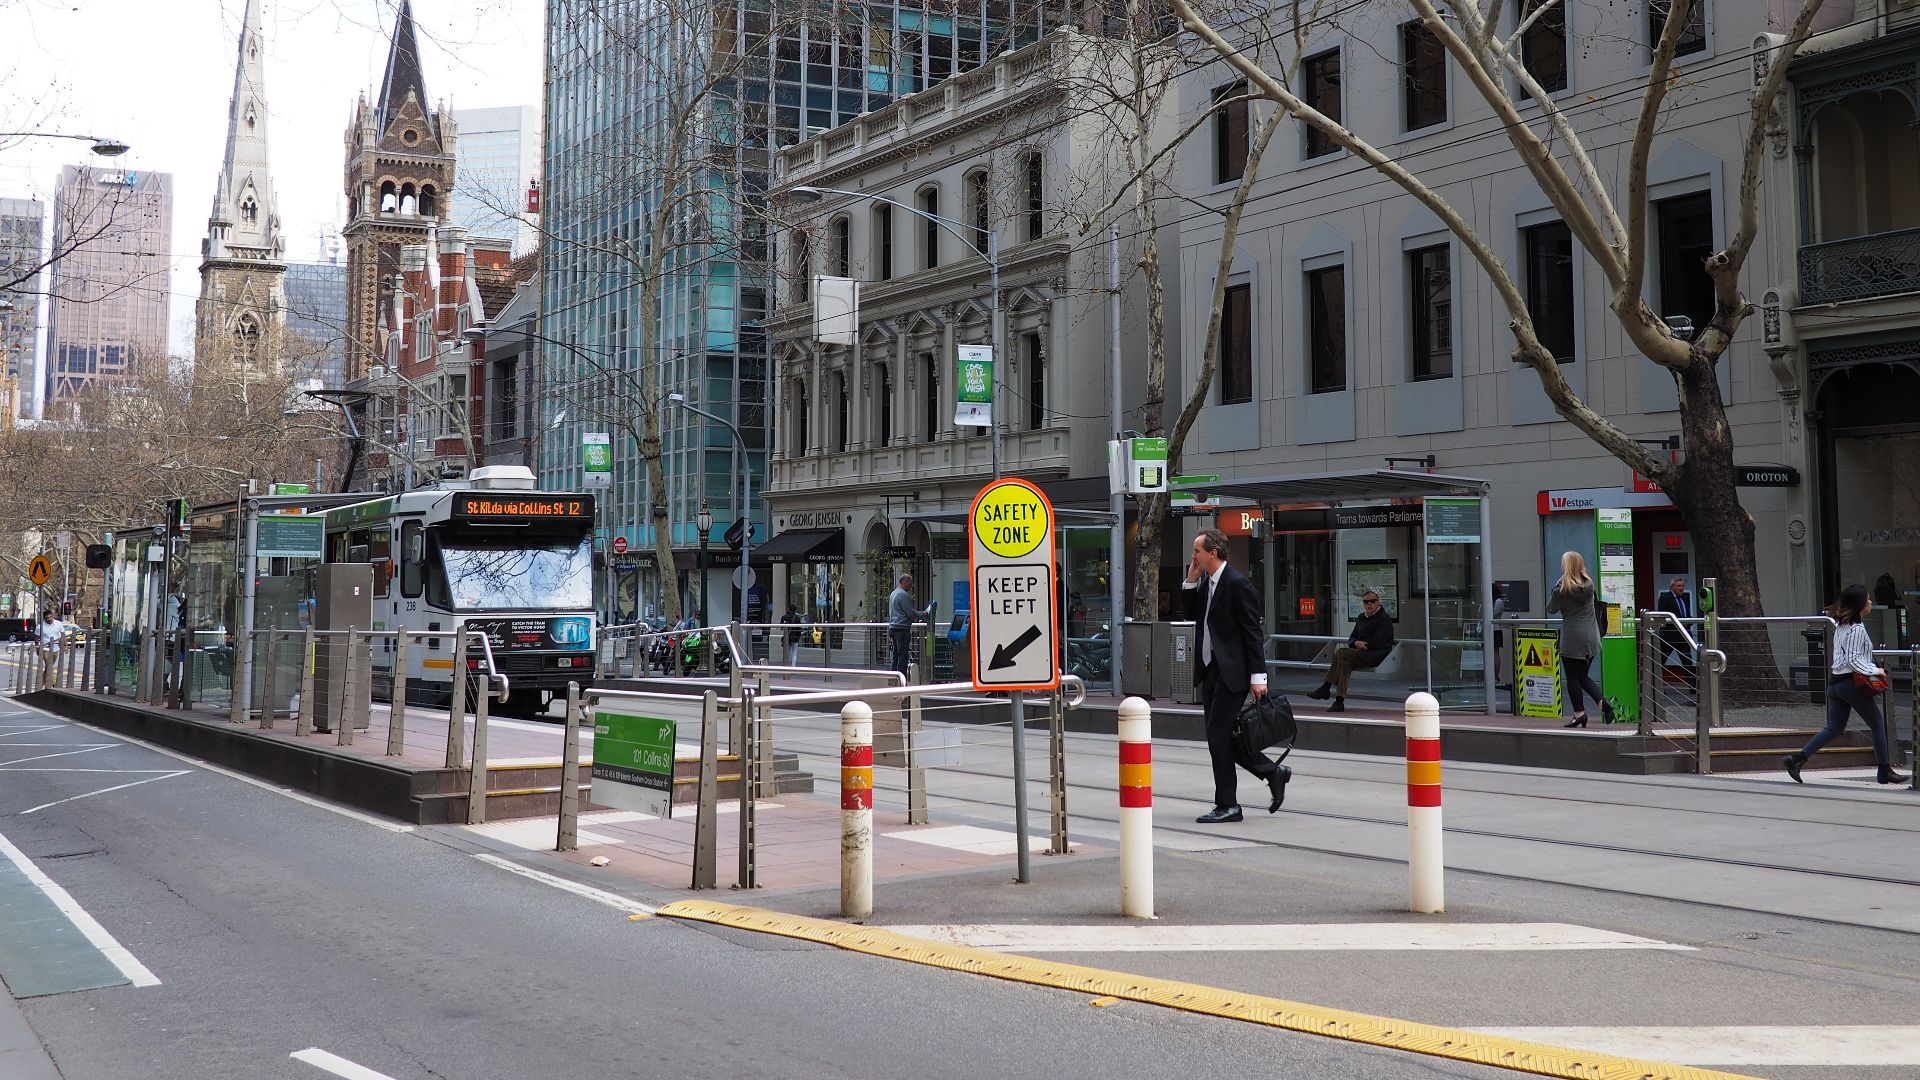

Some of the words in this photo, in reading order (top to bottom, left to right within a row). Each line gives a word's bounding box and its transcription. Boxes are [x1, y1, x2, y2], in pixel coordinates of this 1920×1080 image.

[965, 384, 986, 393] WISH
[1746, 472, 1789, 482] OROTON
[467, 501, 478, 514] St
[480, 501, 503, 514] Kilda
[503, 502, 518, 514] via
[519, 502, 552, 515] Collins
[553, 502, 564, 515] St
[568, 502, 580, 515] 12
[1552, 497, 1594, 508] Westpac
[789, 513, 813, 527] GEORG
[815, 511, 841, 527] JENSEN
[983, 503, 1038, 522] SAFETY
[1336, 513, 1358, 524] Trams
[1358, 512, 1388, 523] towards
[993, 526, 1031, 544] ZONE
[715, 555, 731, 563] Bank
[732, 555, 740, 563] of
[988, 576, 1038, 593] KEEP
[990, 599, 1037, 615] LEFT
[633, 748, 642, 763] 101
[643, 750, 662, 767] Collins
[662, 752, 670, 768] St
[631, 774, 645, 783] Southern
[652, 778, 664, 788] Station
[662, 799, 668, 816] 7
